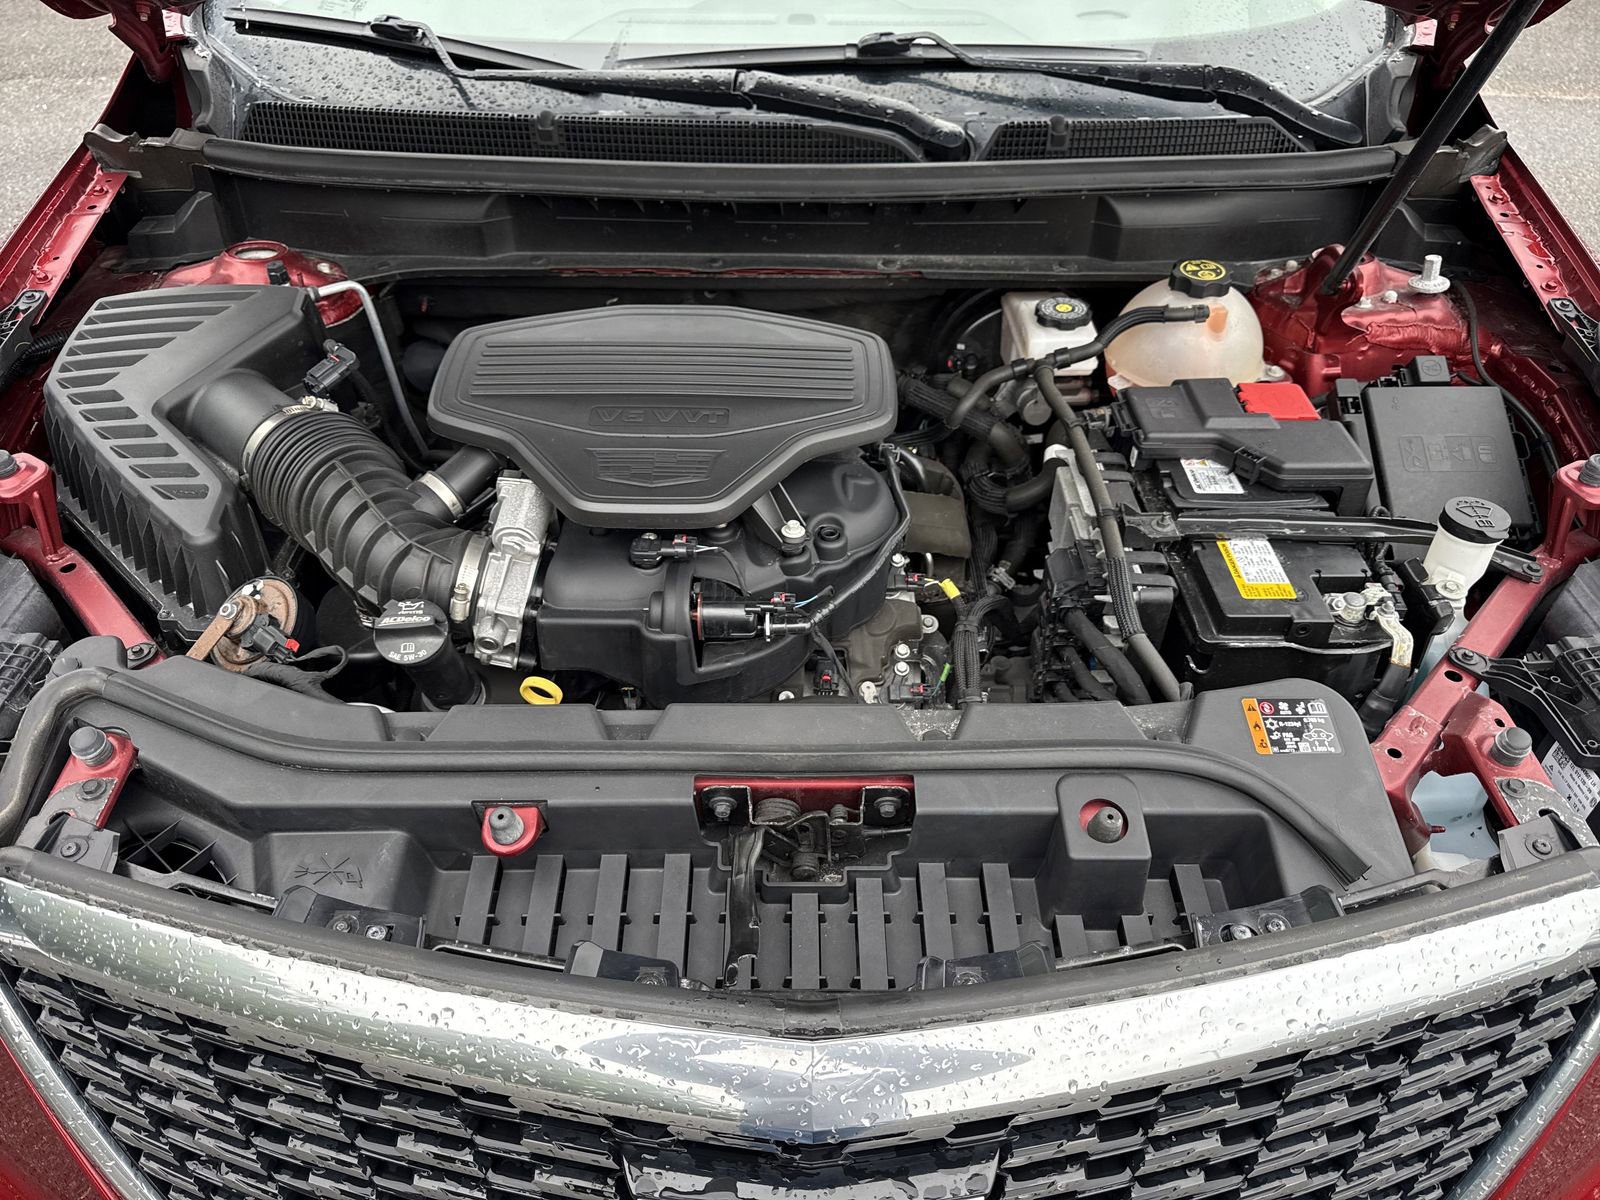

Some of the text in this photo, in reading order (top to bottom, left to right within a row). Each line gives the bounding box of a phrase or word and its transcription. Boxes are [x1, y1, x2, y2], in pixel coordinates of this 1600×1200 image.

[595, 407, 726, 424] V6 VVT
[381, 614, 431, 625] ACDelco
[388, 649, 428, 662] SAE 5W-30
